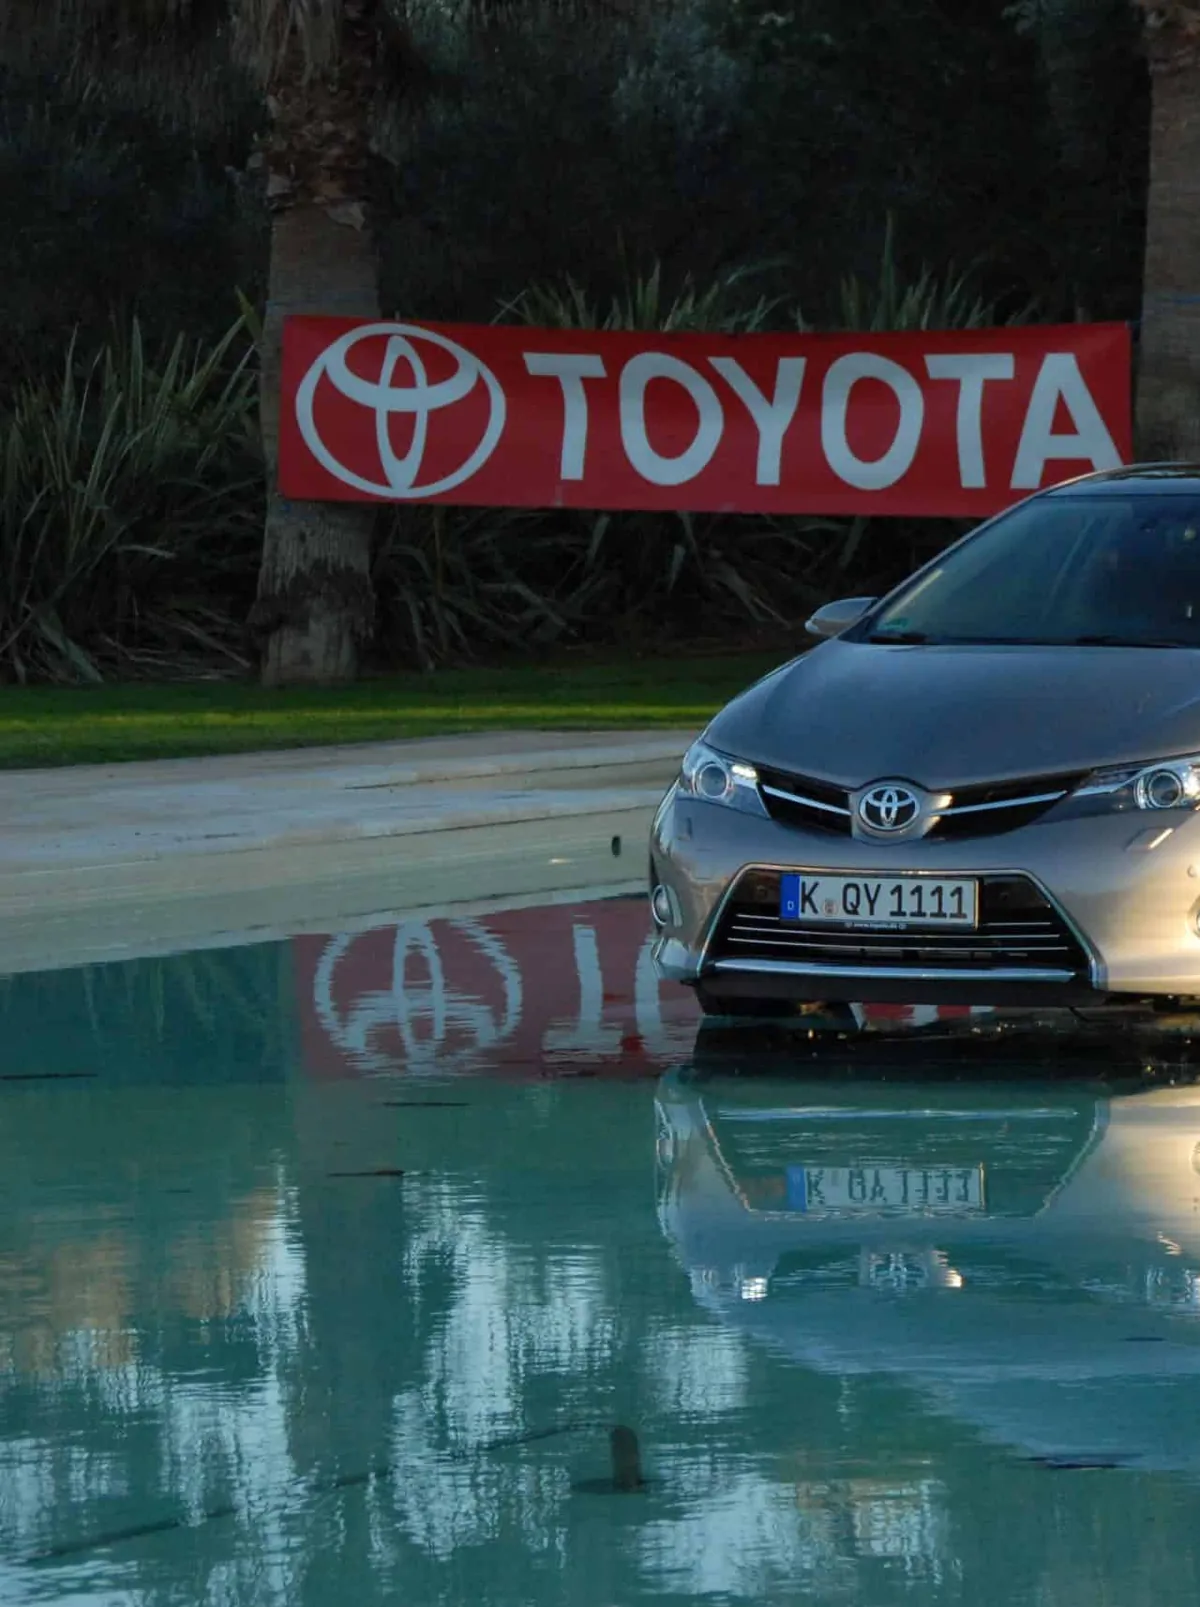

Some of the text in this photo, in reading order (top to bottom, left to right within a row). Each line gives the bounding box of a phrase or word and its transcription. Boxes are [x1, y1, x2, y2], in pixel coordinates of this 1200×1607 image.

[522, 351, 1123, 490] TOYOTA
[801, 881, 968, 918] K QY 1111
